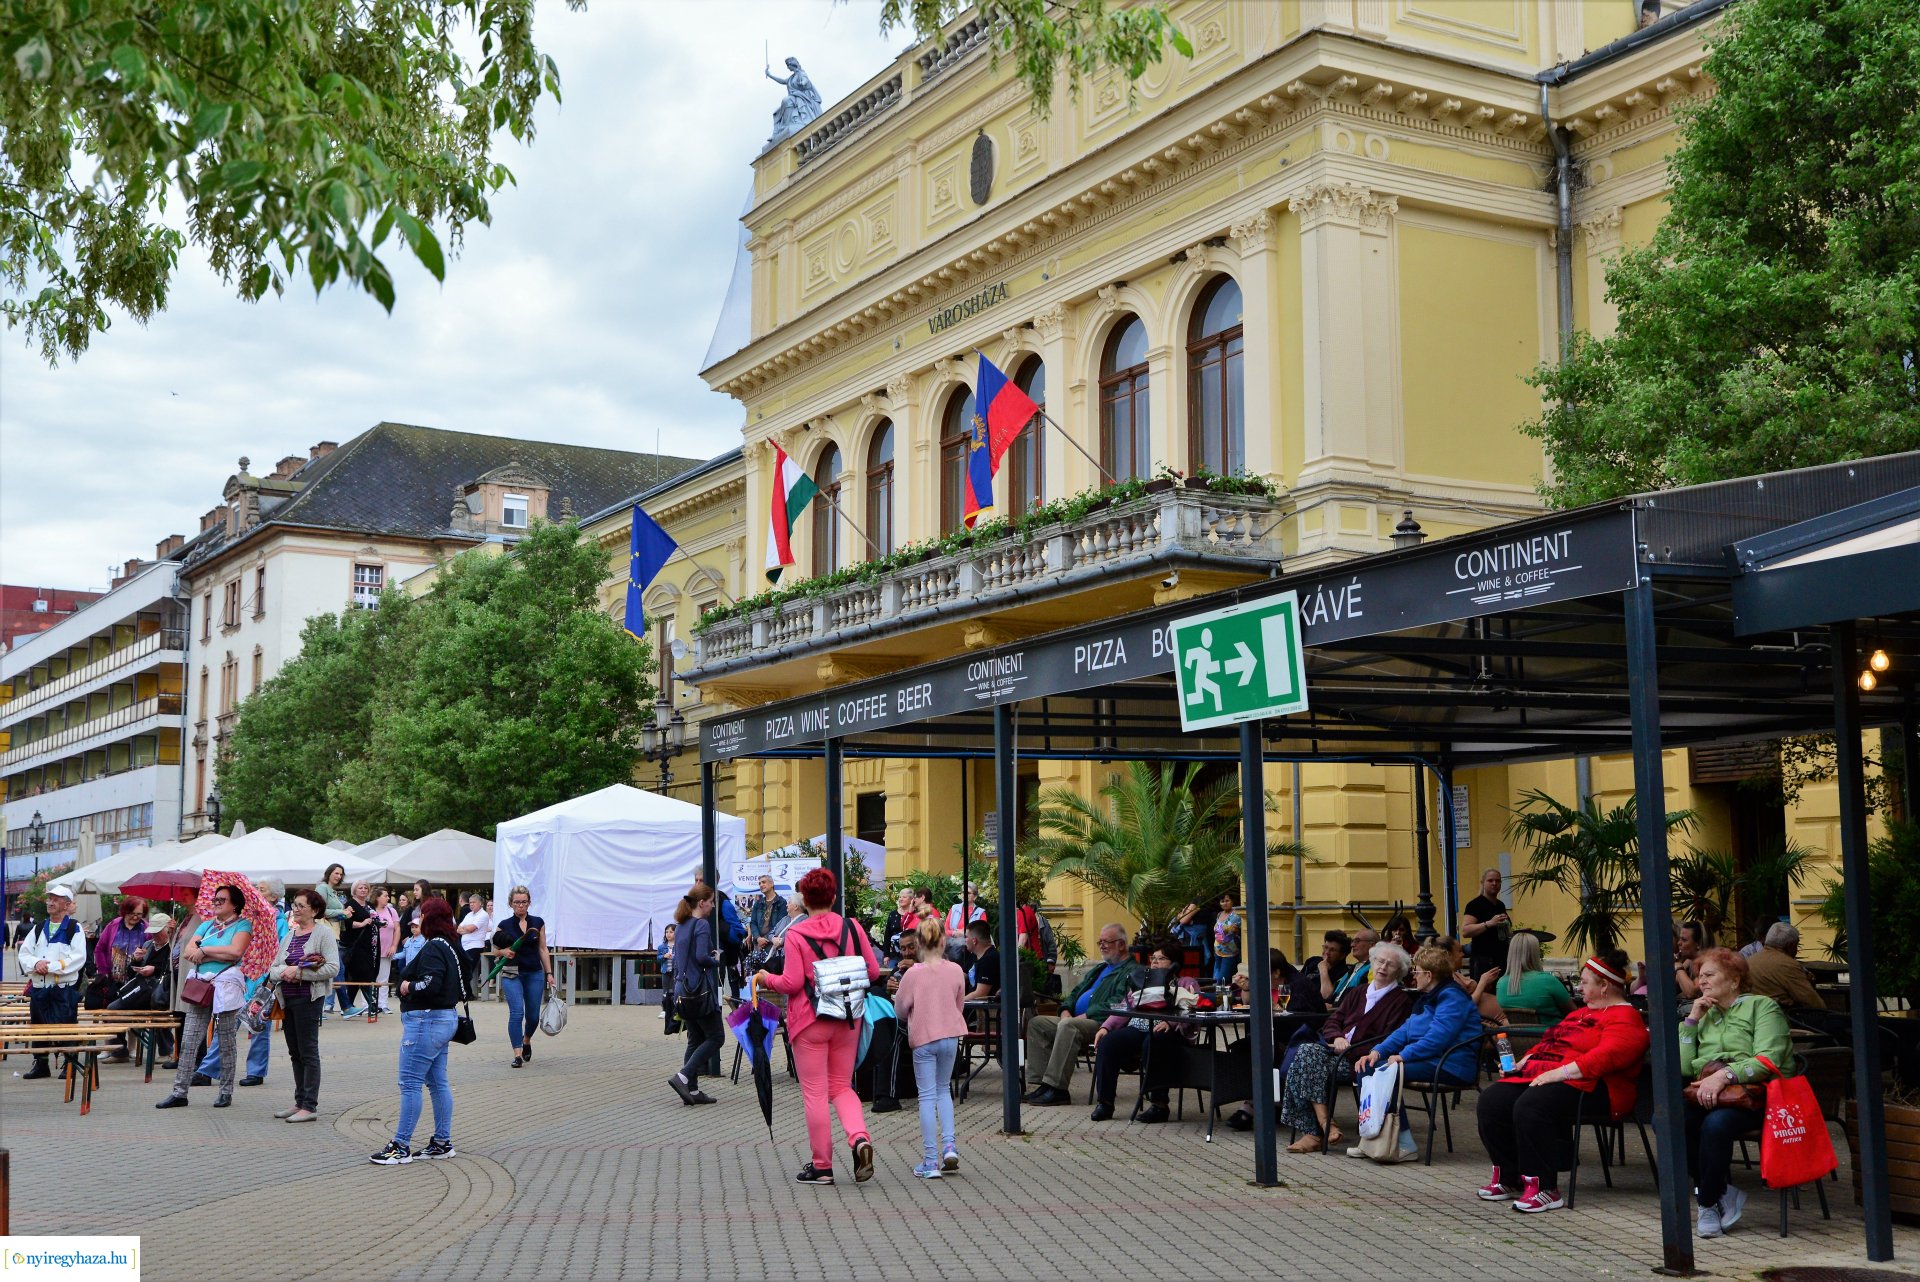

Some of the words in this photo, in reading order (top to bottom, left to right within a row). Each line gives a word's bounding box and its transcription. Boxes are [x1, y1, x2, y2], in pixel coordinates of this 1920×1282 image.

[928, 281, 1008, 334] VÁROSHÁZA
[1454, 529, 1573, 580] CONTINENT
[1477, 577, 1501, 592] WINE
[1504, 575, 1512, 587] &
[1515, 567, 1550, 585] COFFEE
[1074, 636, 1128, 675] PIZZA
[1299, 576, 1363, 627] KÁVÉ
[967, 652, 1024, 682] CONTINENT
[977, 681, 990, 691] WINE
[996, 676, 1014, 688] COFFEE
[766, 715, 795, 741] PIZZA
[800, 706, 830, 734] WINE
[838, 693, 888, 726] COFFEE
[897, 682, 933, 714] BEER
[712, 719, 746, 739] CONTINENT
[737, 874, 760, 882] VENDÉ
